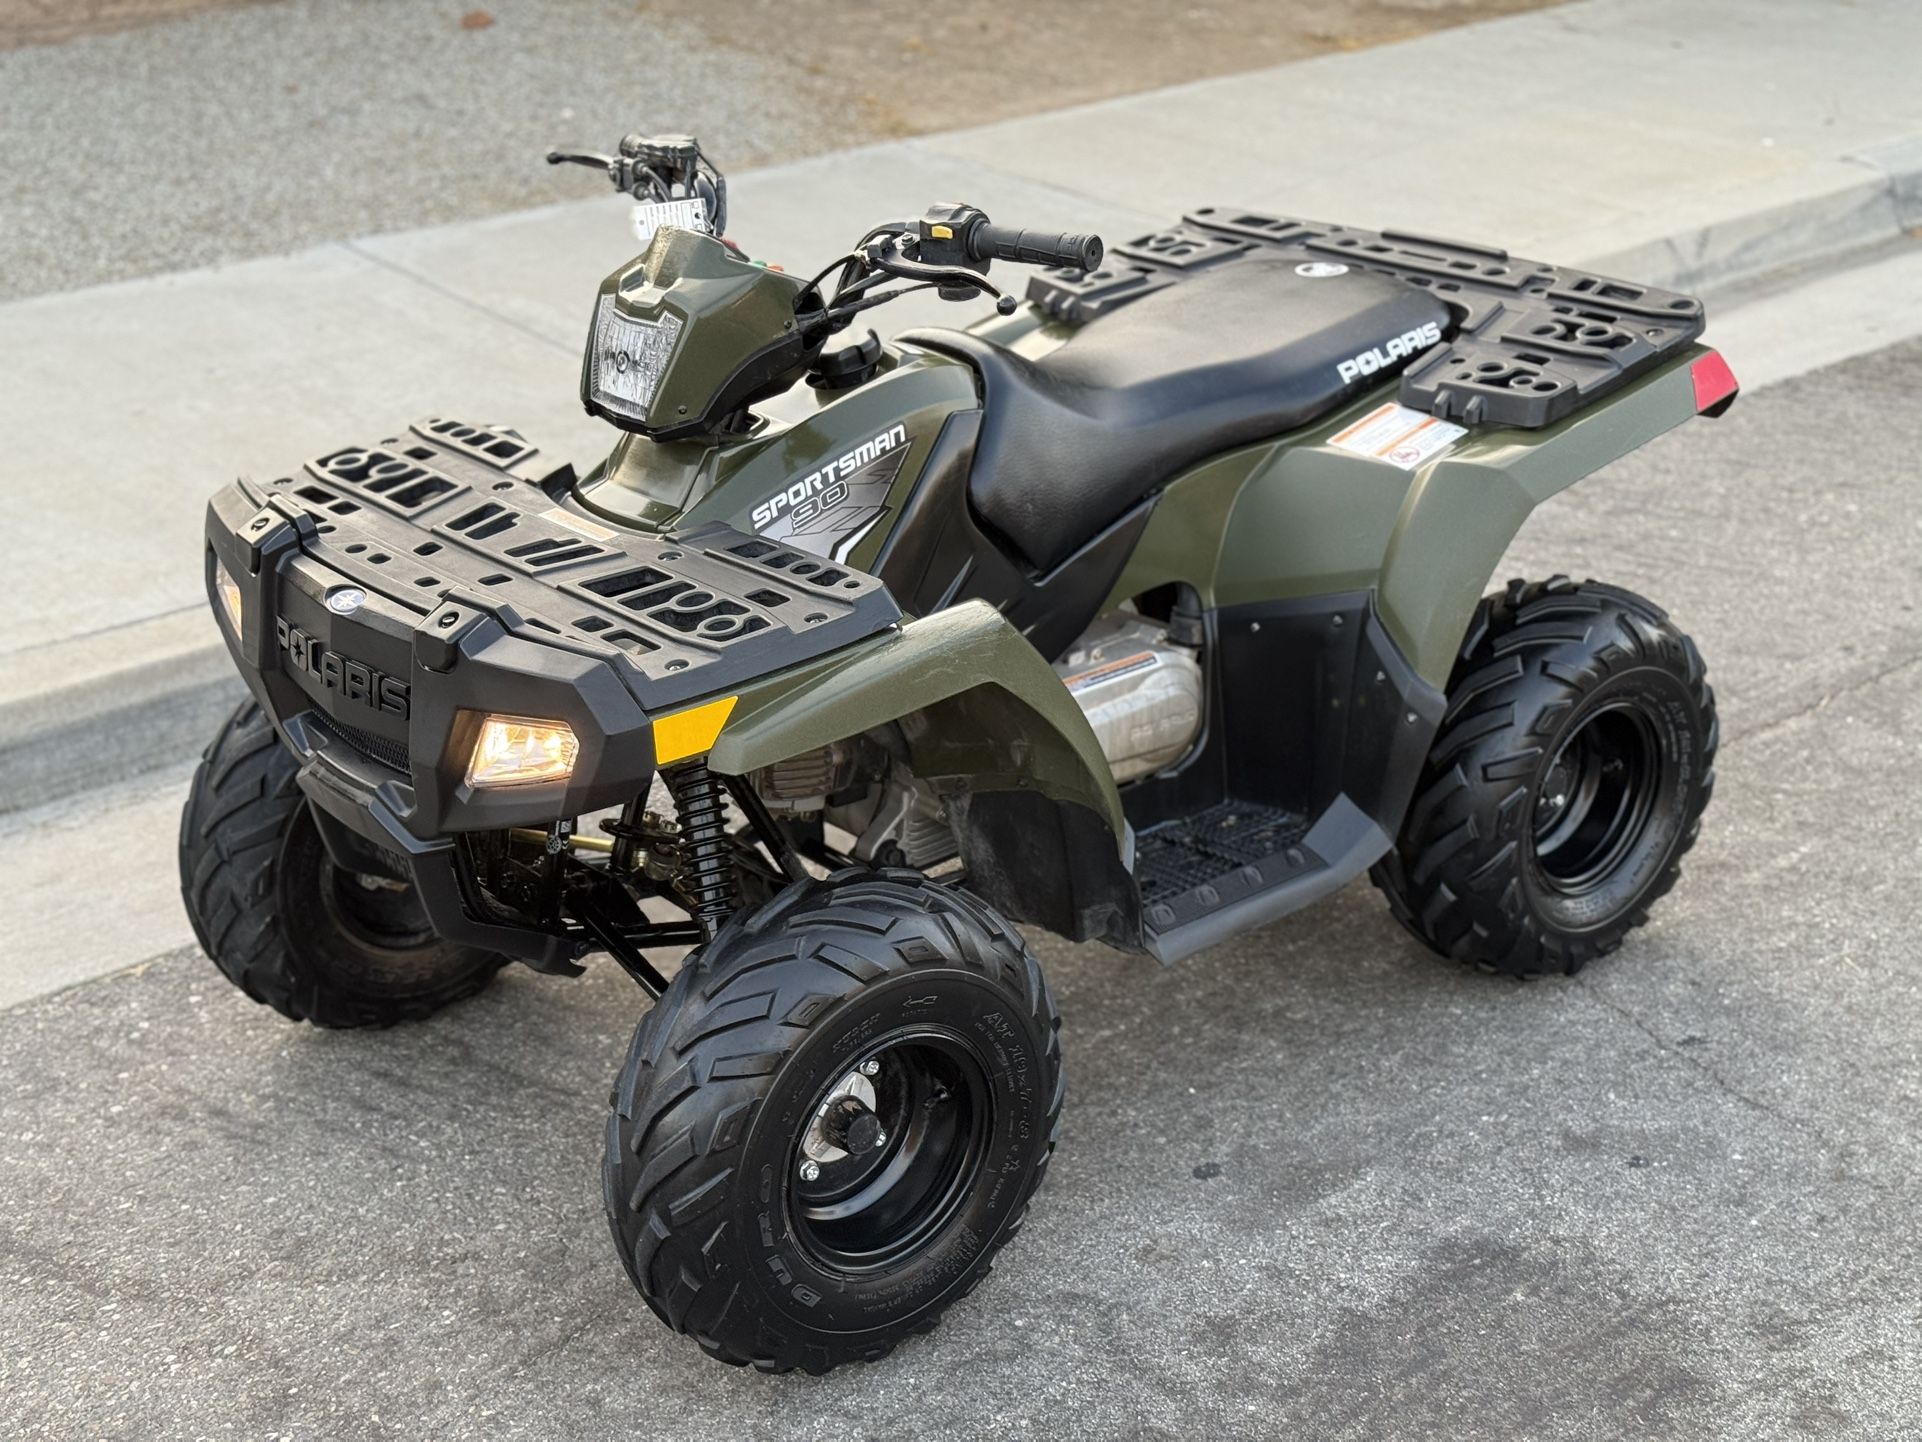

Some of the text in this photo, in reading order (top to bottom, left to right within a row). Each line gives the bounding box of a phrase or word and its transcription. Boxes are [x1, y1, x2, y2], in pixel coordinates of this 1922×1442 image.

[1336, 321, 1442, 384] POLARIS
[751, 424, 906, 530] SPORTSMAN
[791, 480, 848, 529] 90
[276, 615, 411, 721] POLARIS
[757, 1163, 823, 1308] DURO
